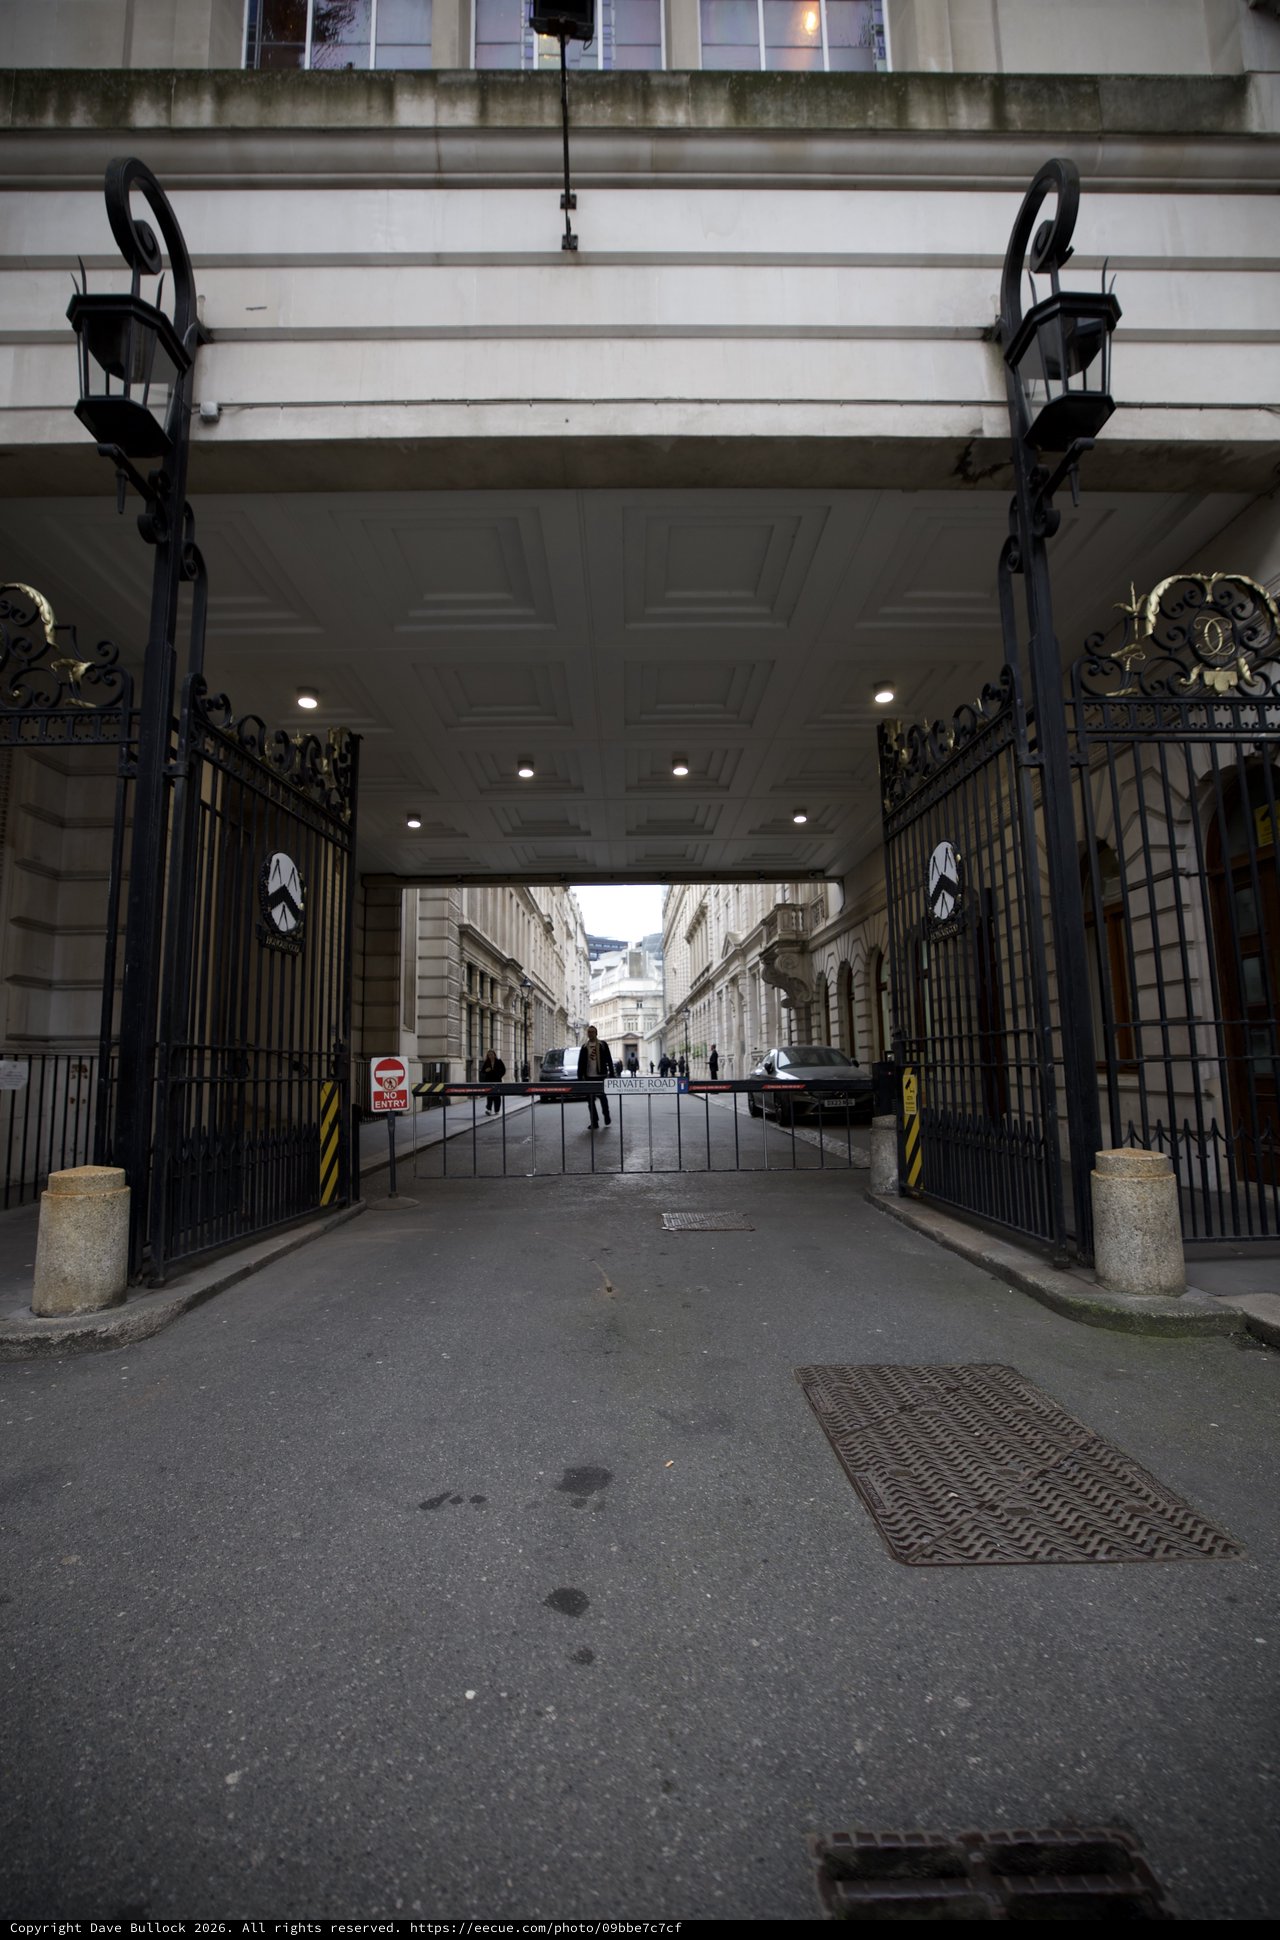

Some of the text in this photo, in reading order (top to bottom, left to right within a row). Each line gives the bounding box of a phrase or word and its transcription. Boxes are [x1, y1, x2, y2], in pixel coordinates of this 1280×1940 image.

[607, 1079, 676, 1088] PRIVATE ROAD
[375, 1100, 405, 1108] ENTRY
